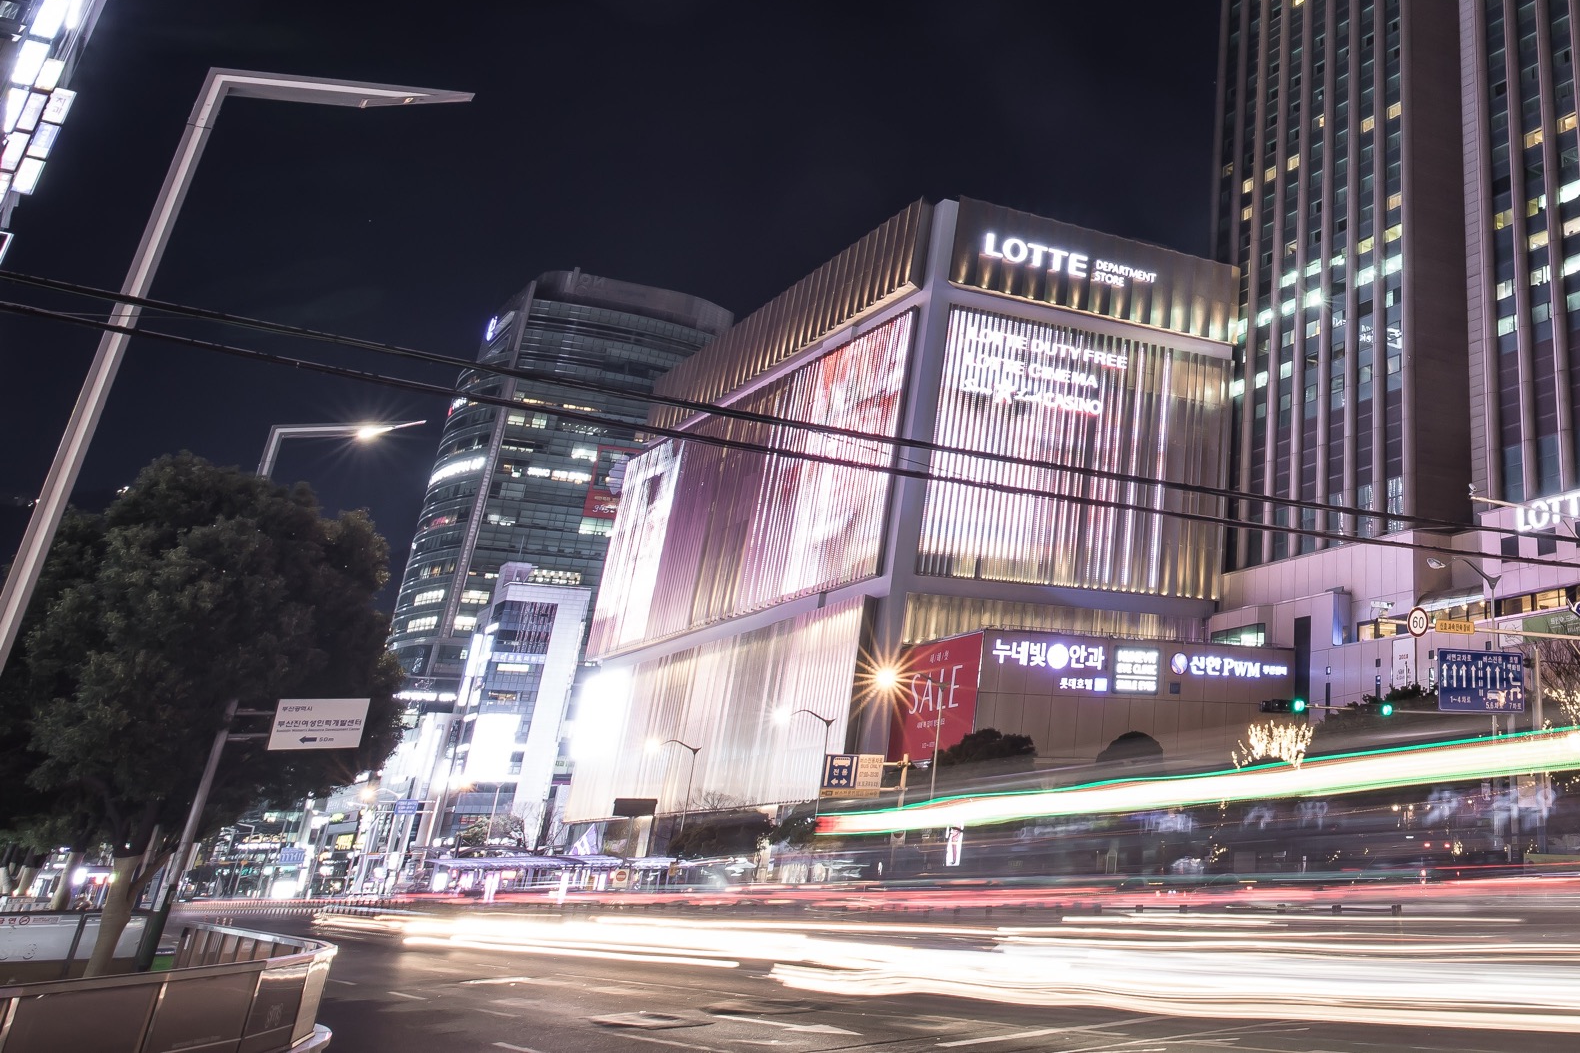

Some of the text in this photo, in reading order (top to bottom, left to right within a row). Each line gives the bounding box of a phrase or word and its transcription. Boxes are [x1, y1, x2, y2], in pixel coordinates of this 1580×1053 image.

[985, 232, 1089, 278] LOTTE
[1093, 270, 1125, 287] STORE
[1096, 259, 1157, 283] DEPARTMENT
[1031, 338, 1082, 360] DUTY
[1083, 348, 1128, 369] FREE
[1028, 362, 1099, 388] CINEMA
[1043, 391, 1103, 415] CASINO
[1412, 616, 1425, 629] 60
[992, 639, 1105, 670] 누네빛 안과
[908, 664, 963, 715] SALE
[277, 718, 363, 728] 부산진여성인력개발센터
